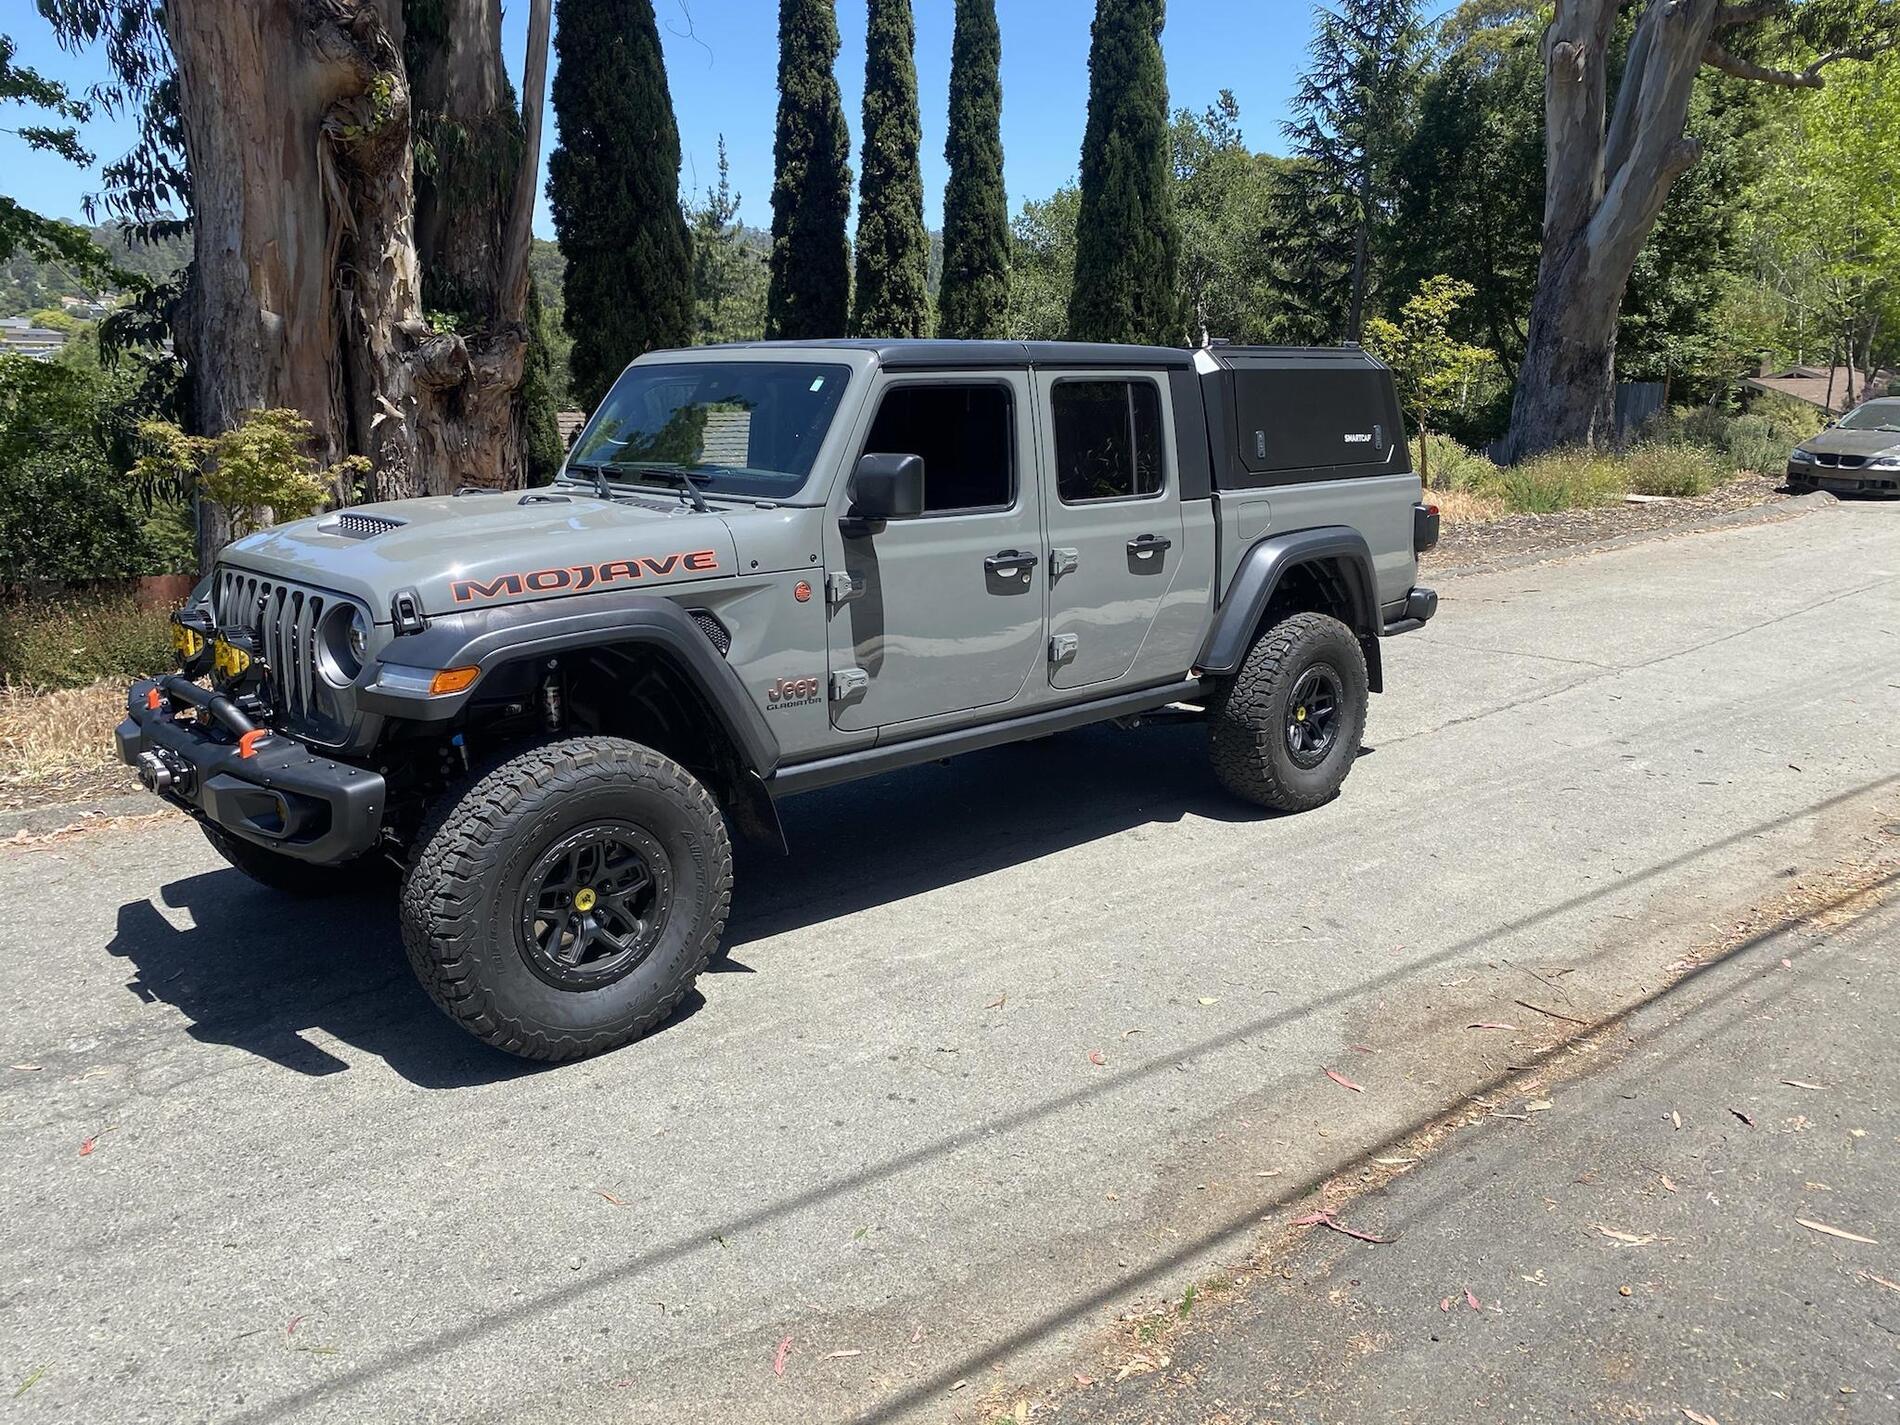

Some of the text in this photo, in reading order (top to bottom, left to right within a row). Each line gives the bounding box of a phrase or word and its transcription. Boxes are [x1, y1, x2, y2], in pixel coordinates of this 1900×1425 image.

[451, 550, 718, 603] MOJAVE
[768, 677, 819, 702] Jeep
[767, 698, 822, 711] GLADIATOR
